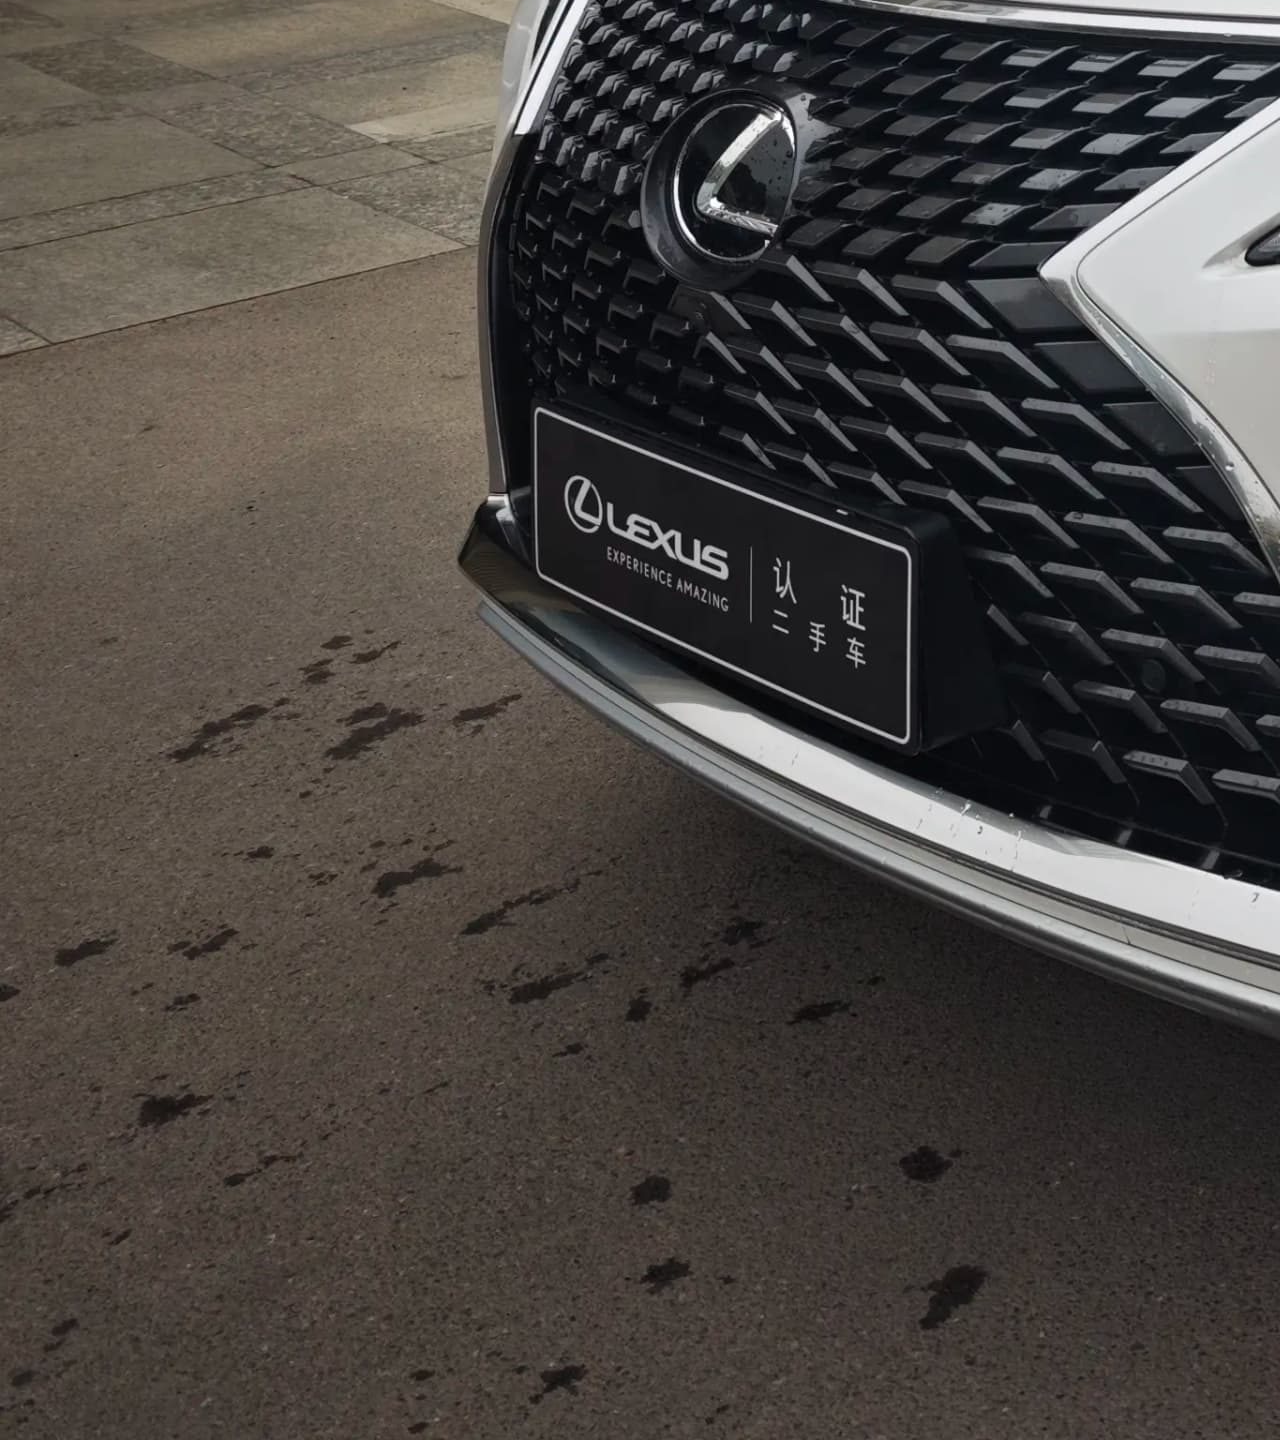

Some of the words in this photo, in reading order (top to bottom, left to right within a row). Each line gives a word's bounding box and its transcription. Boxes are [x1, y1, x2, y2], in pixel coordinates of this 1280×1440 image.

[607, 502, 729, 580] LEXUS
[607, 547, 673, 588] EXPERIENCE
[676, 578, 729, 612] AMAZING
[773, 557, 867, 631] 认证
[772, 609, 867, 669] 二手车
